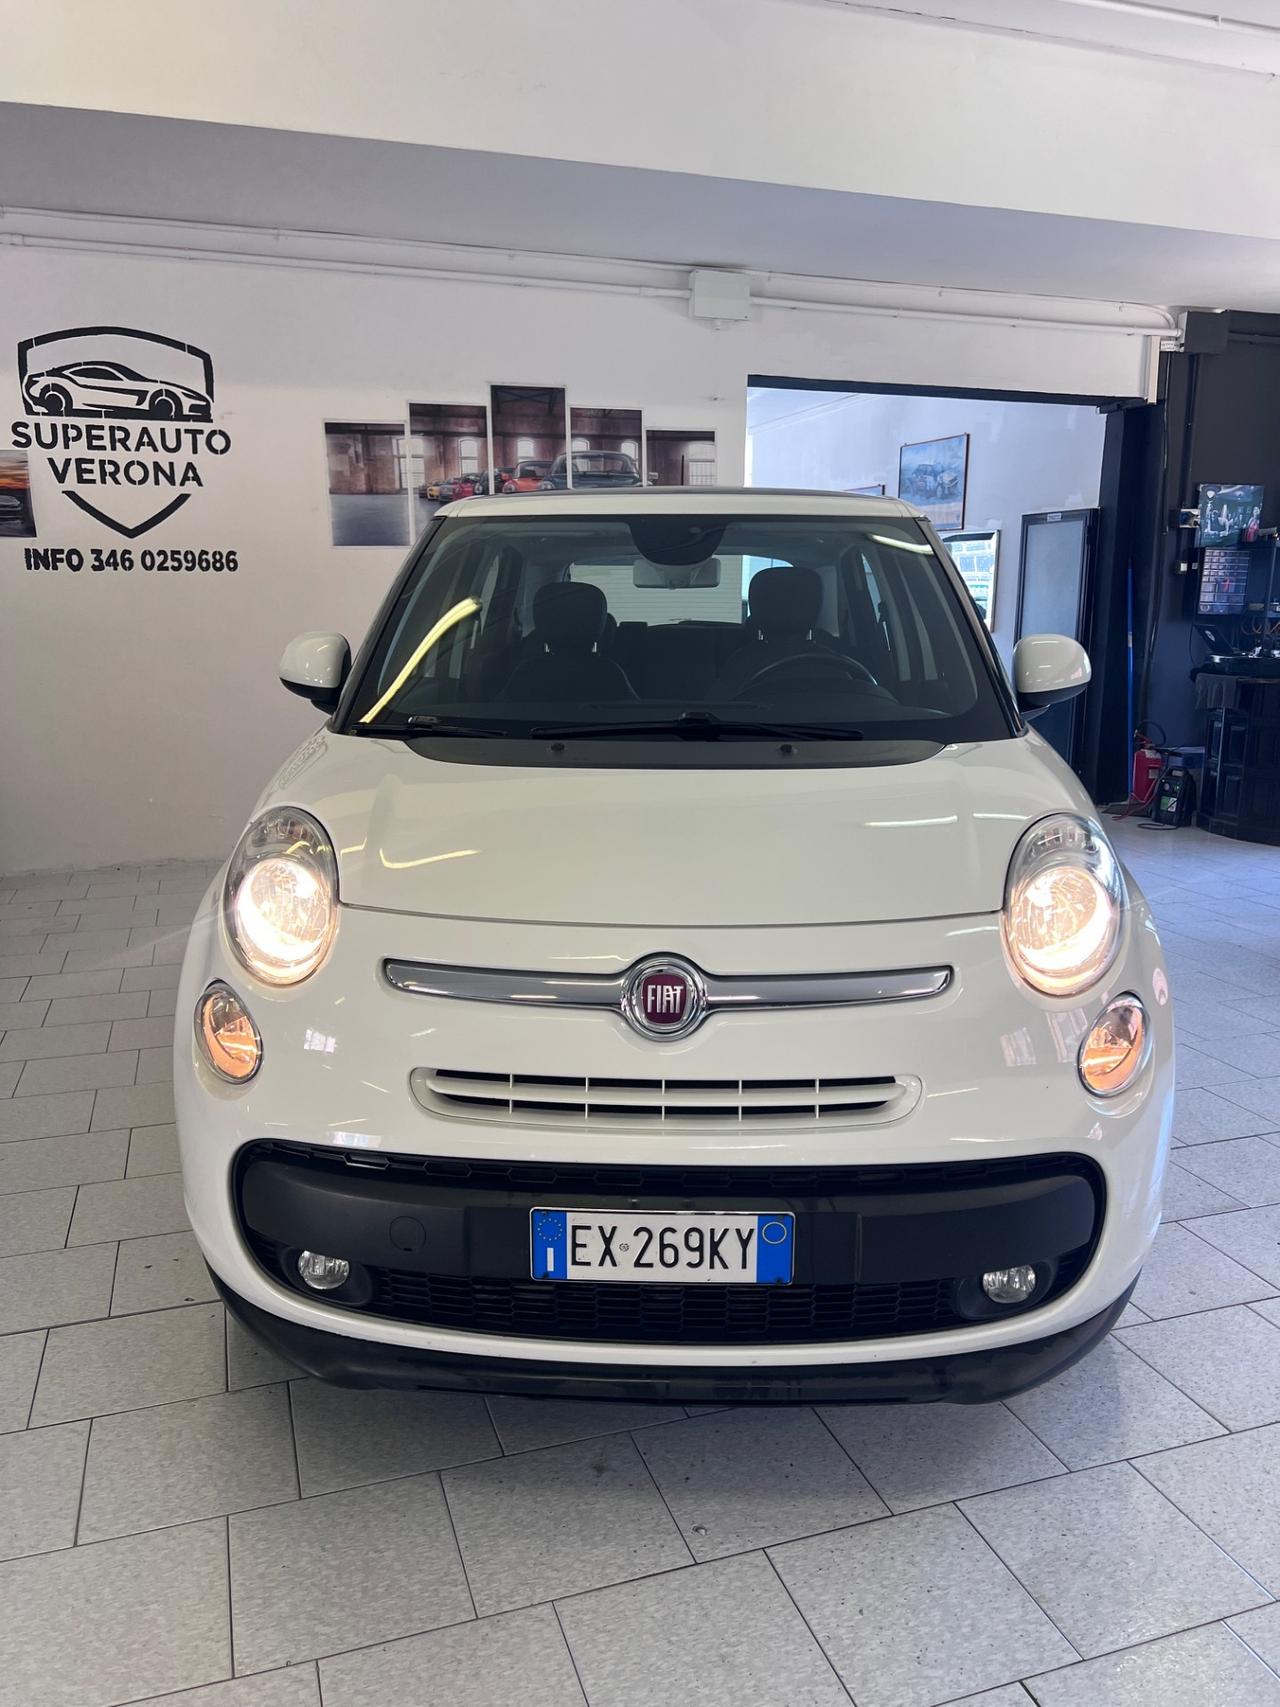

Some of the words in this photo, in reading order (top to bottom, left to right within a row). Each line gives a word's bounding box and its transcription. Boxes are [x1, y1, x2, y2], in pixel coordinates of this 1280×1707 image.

[11, 421, 232, 455] SUPERAUTO
[47, 457, 204, 487] VERONA
[24, 547, 84, 572] INFO
[90, 548, 134, 572] 346
[140, 549, 239, 572] 0259686
[647, 984, 684, 1013] FIAT
